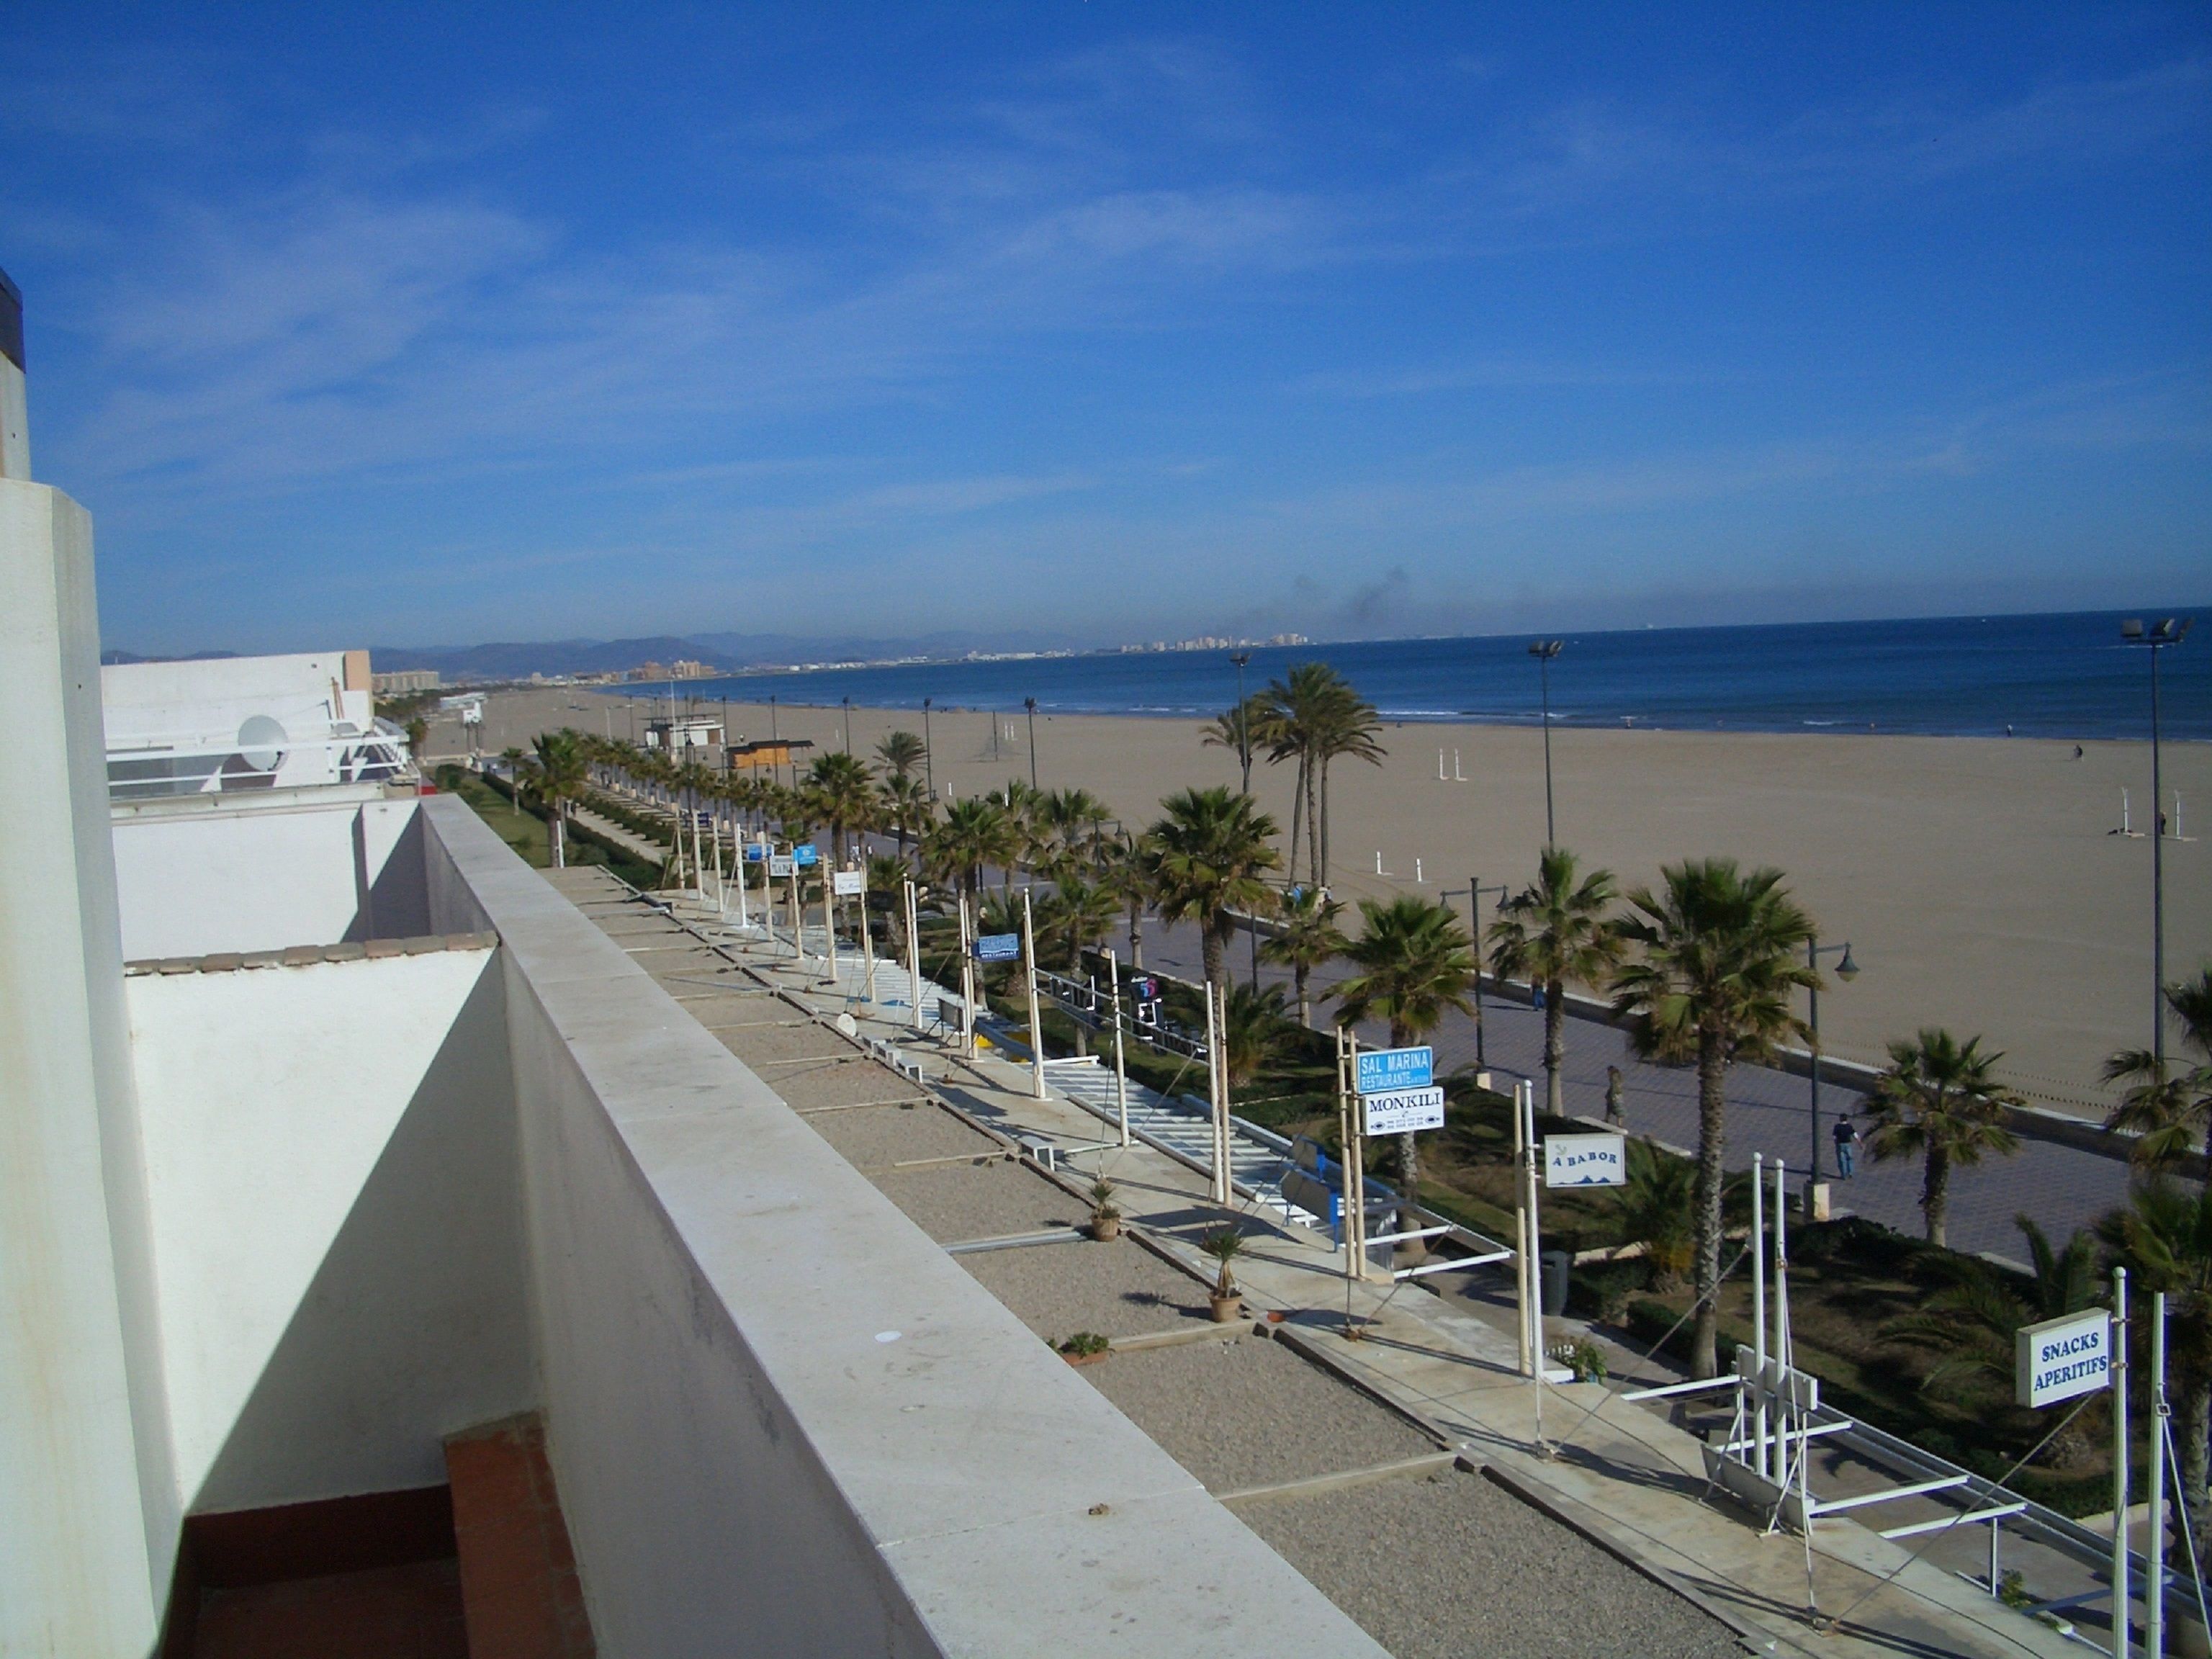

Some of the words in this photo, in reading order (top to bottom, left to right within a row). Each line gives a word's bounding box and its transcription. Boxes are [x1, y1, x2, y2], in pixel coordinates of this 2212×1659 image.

[1362, 1056, 1382, 1075] SAL
[1387, 1051, 1429, 1073] MARINA
[1361, 1071, 1411, 1090] RESTAURANTE
[1369, 1092, 1440, 1112] MONKILI
[1552, 1157, 1563, 1167] A
[1566, 1151, 1617, 1167] BABOR
[2041, 1332, 2099, 1362] SNACKS
[2033, 1355, 2107, 1392] APERITIFS
